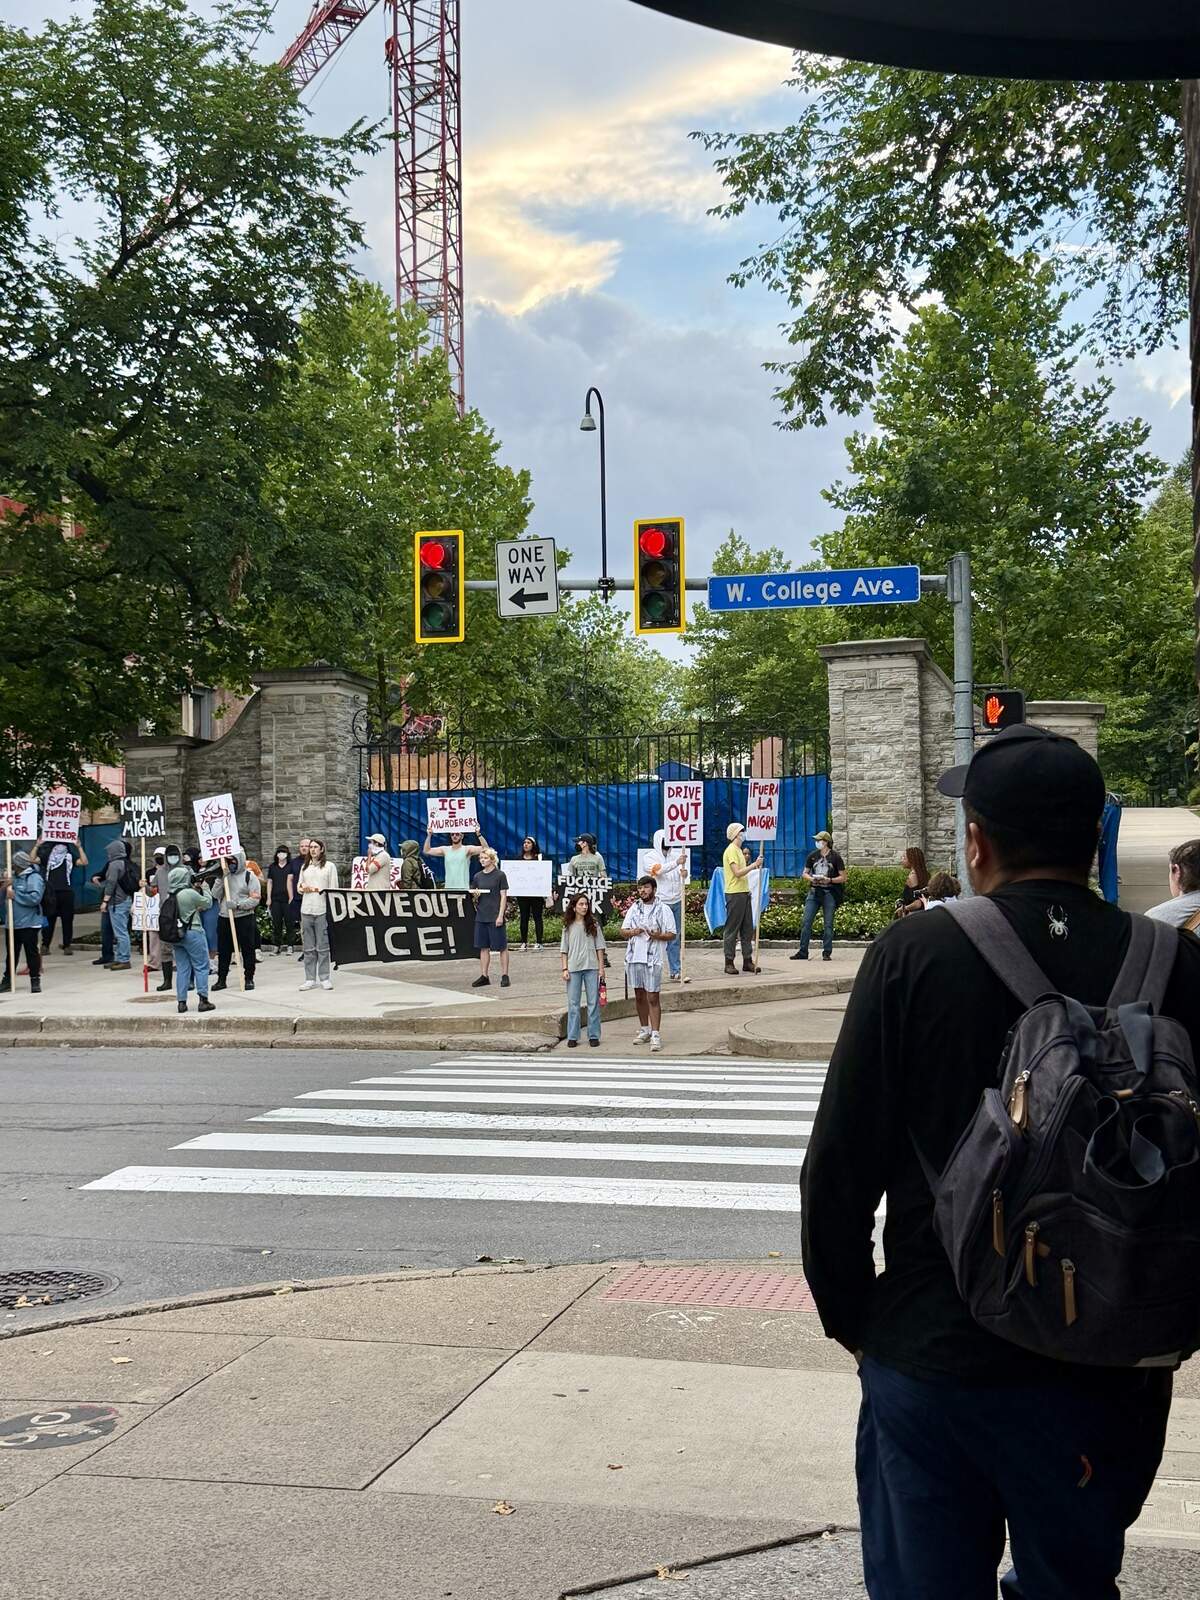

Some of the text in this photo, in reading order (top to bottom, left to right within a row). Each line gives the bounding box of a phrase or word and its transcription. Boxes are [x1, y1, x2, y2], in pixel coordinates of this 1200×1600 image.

[508, 545, 545, 564] ONE
[508, 565, 546, 584] WAY
[726, 576, 901, 605] W. College Ave.
[667, 785, 702, 801] DRIVE
[47, 795, 80, 809] SCPD
[120, 794, 163, 815] ¡CHINGA
[438, 798, 466, 811] ICE
[758, 797, 773, 811] LA
[133, 811, 149, 822] LA
[667, 802, 702, 822] OUT
[48, 820, 71, 830] ICE
[122, 816, 167, 837] MIGRA!
[430, 817, 478, 829] MURDERERS
[747, 815, 777, 830] MIGRA!
[44, 830, 77, 841] TERROR
[669, 824, 698, 842] ICE
[205, 835, 233, 848] STOP
[209, 845, 232, 858] ICE
[557, 875, 591, 888] FUCK
[591, 877, 613, 890] ICE
[328, 891, 467, 922] DRIVE OUT
[364, 925, 457, 956] ICE!
